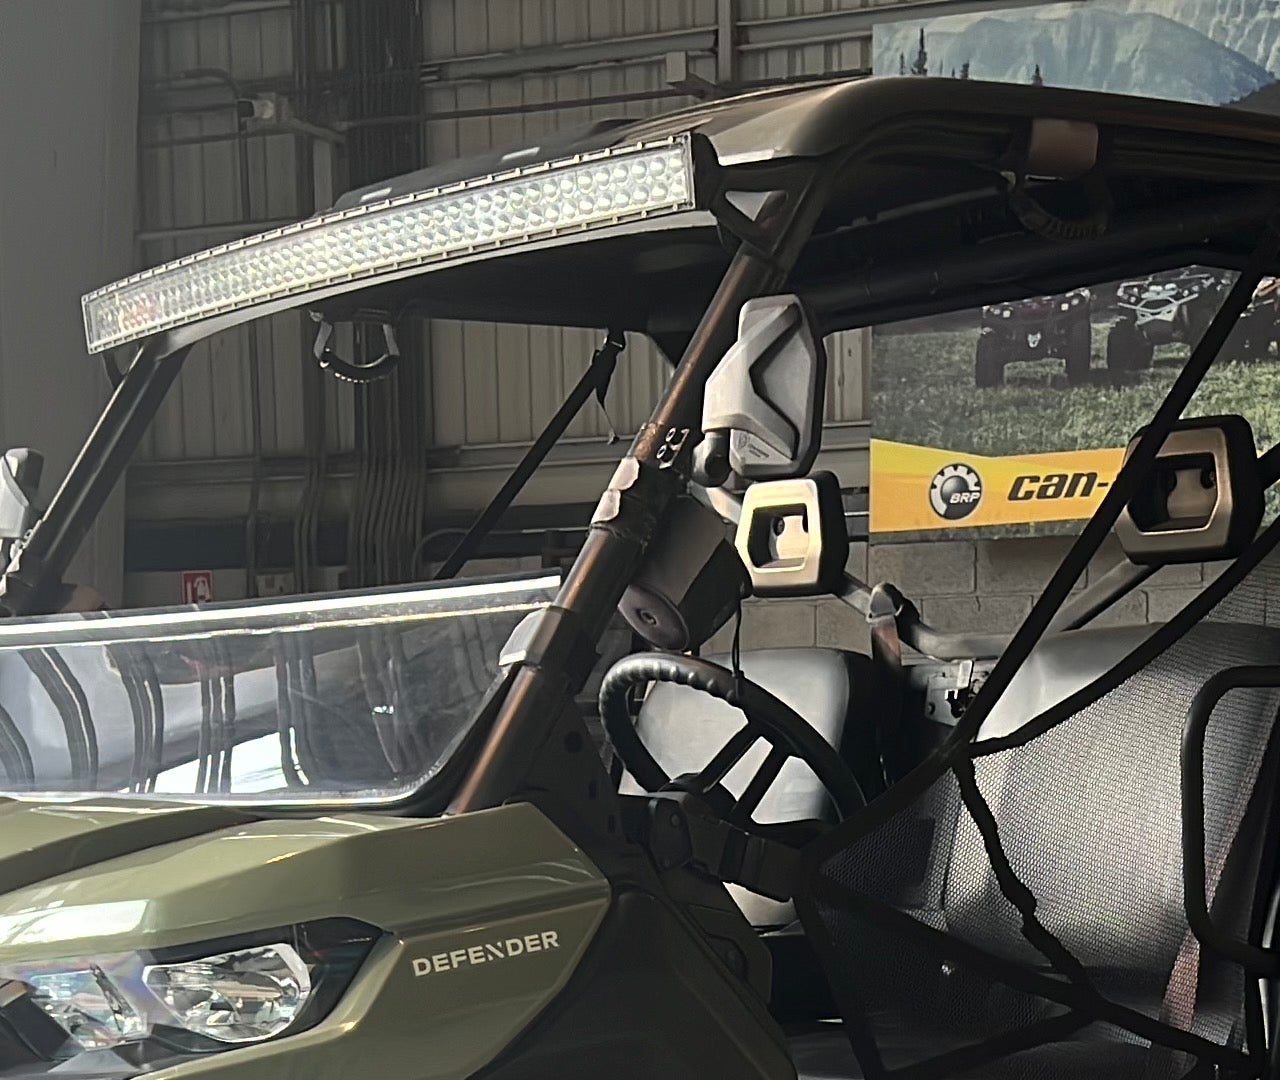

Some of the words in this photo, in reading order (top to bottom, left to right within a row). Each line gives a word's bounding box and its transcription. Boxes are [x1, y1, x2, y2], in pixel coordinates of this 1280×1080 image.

[949, 492, 981, 504] BRP
[1007, 472, 1109, 501] can-
[412, 930, 560, 977] DEFENDER
